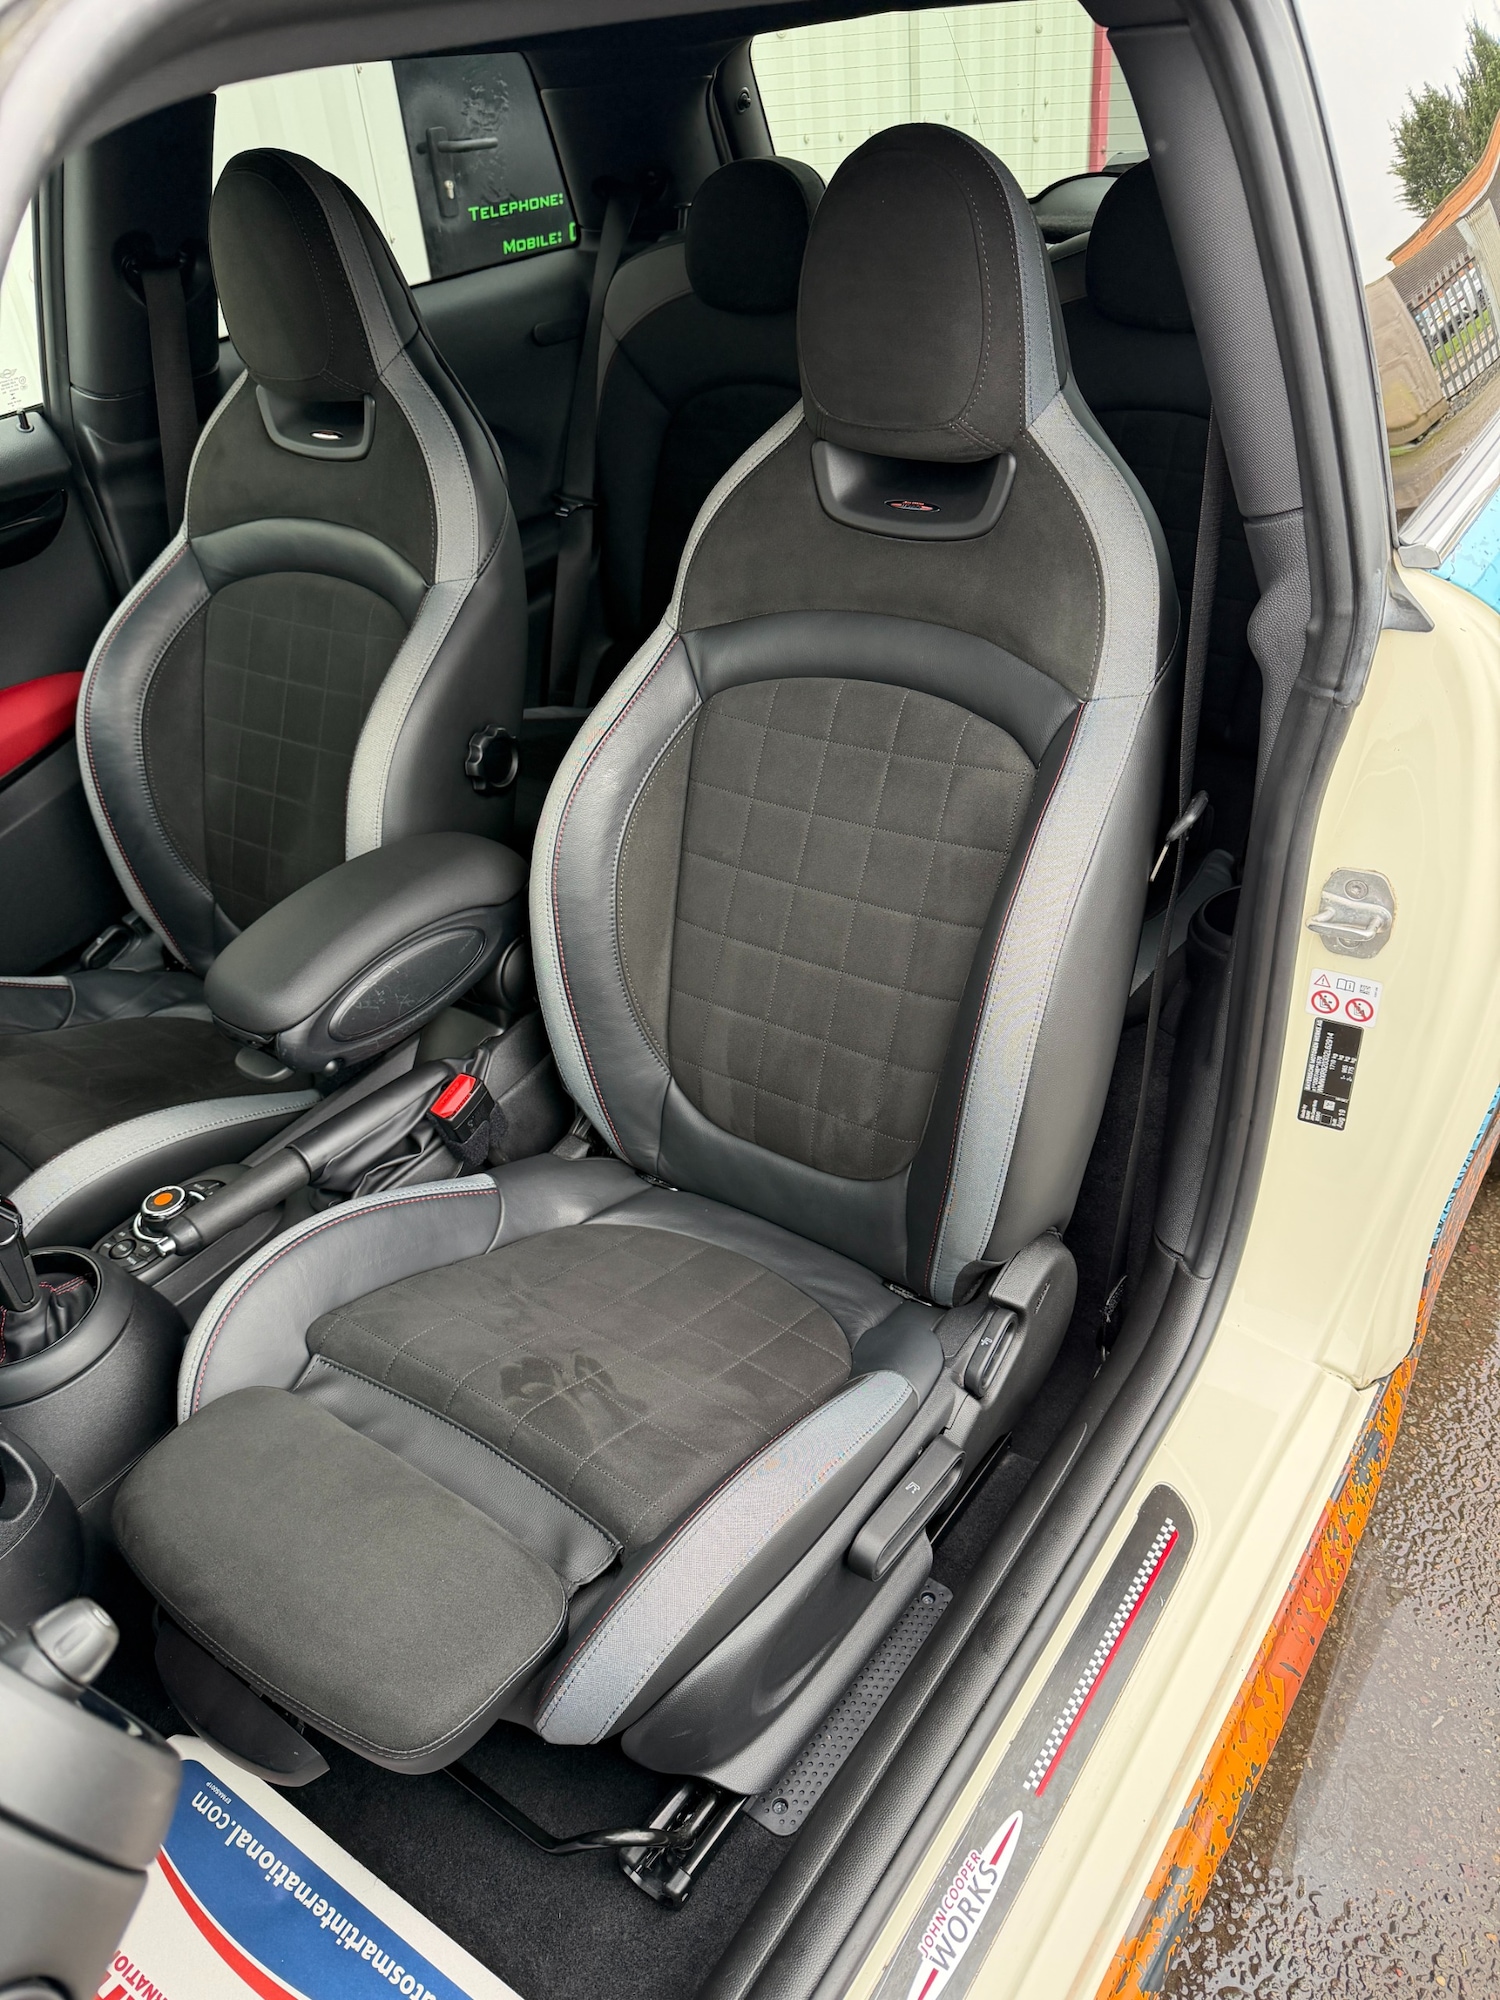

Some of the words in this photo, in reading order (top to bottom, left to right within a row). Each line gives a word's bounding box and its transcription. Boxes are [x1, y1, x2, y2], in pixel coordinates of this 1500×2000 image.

[919, 1911, 946, 1957] JOHN
[943, 1852, 981, 1909] COOPER
[929, 1859, 998, 1971] WORKS
